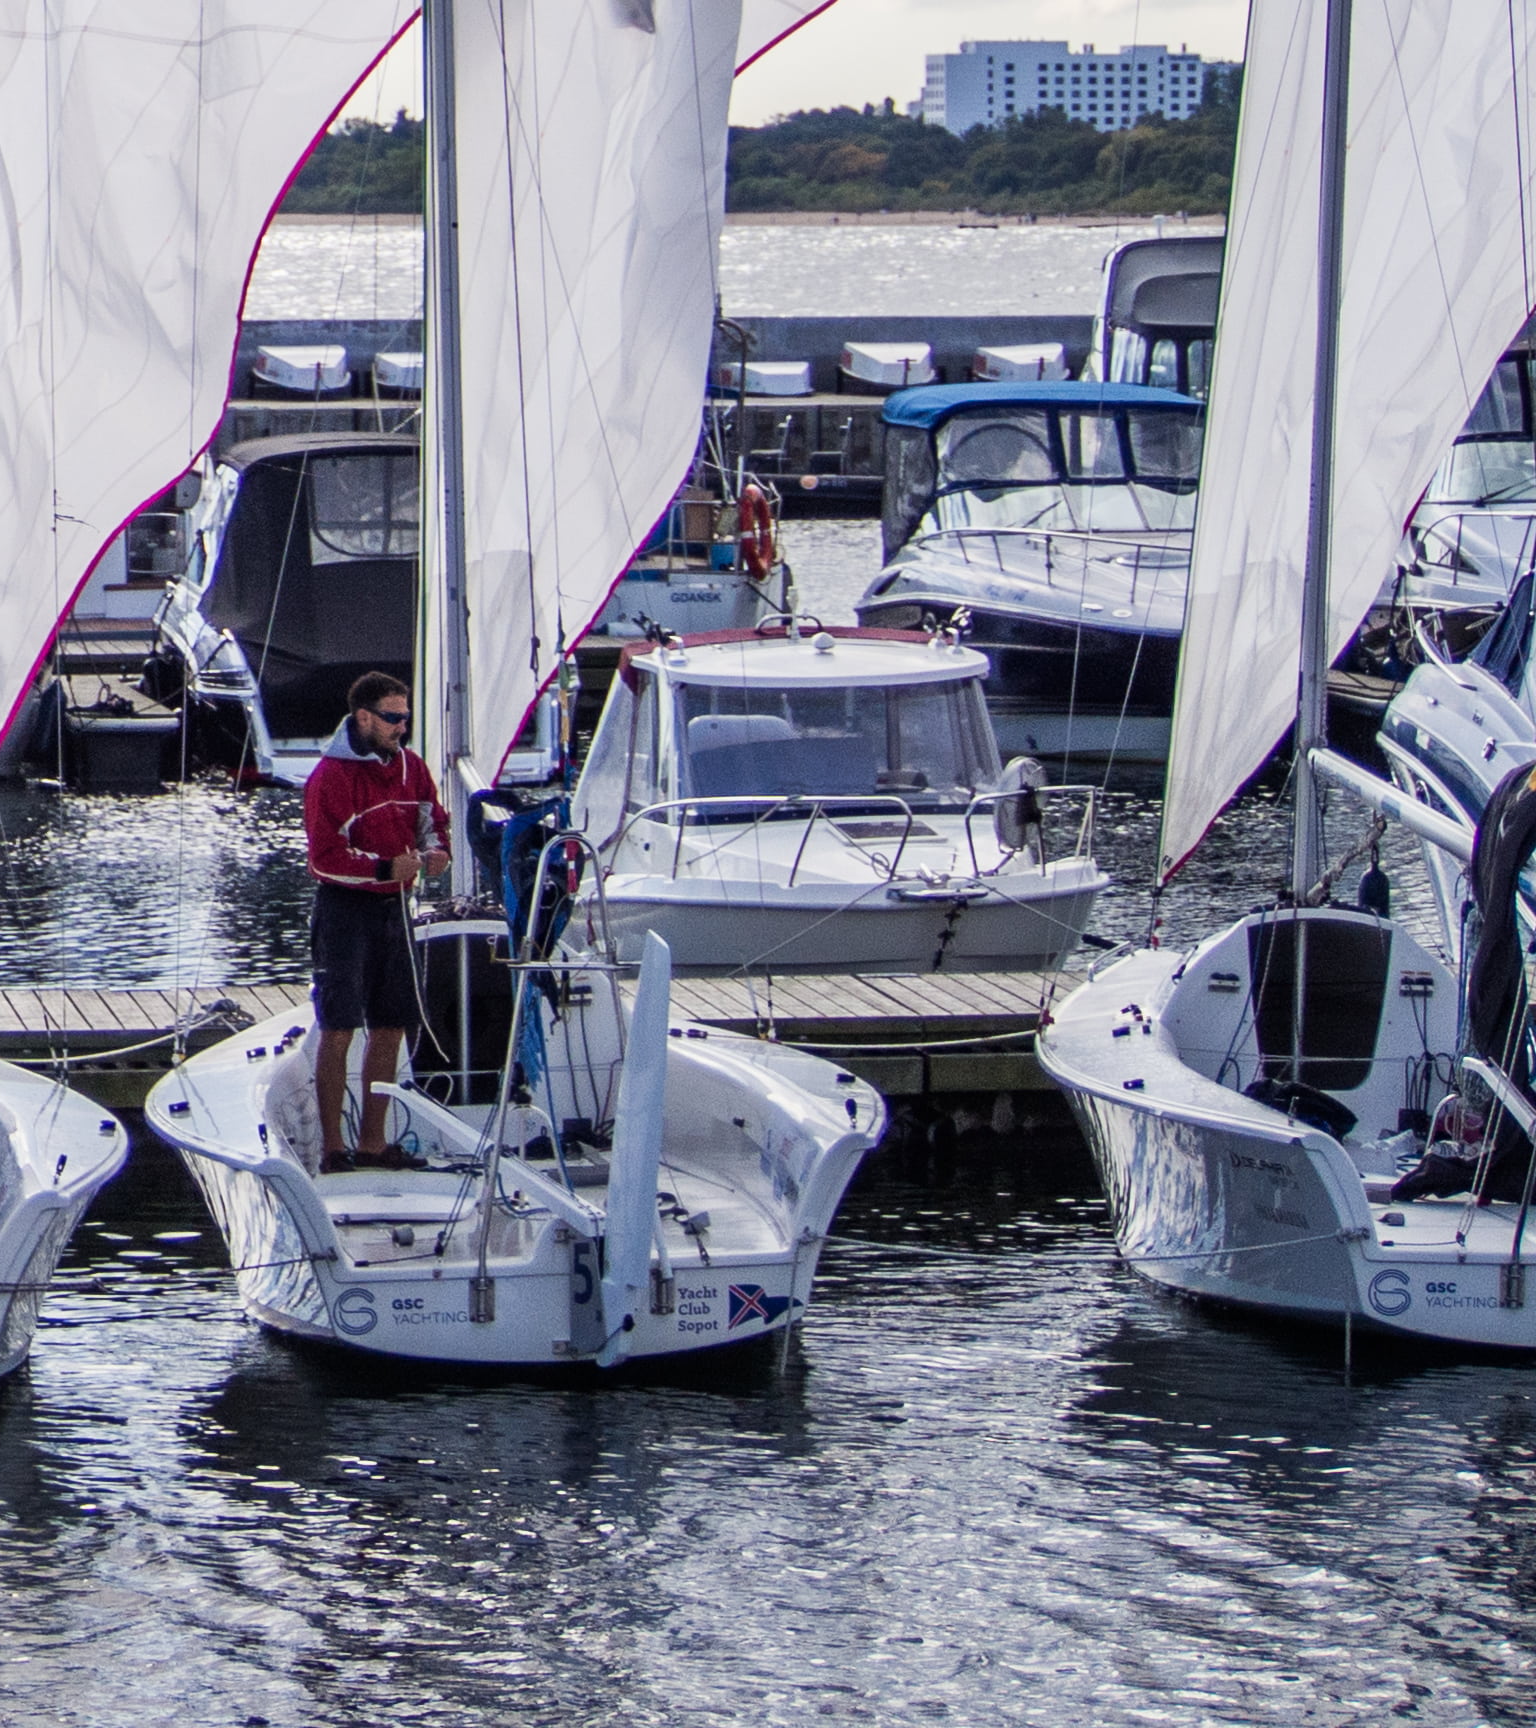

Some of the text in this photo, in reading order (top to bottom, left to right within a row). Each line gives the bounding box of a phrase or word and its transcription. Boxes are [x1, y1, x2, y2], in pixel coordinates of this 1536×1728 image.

[574, 1242, 593, 1305] 5
[1426, 1282, 1457, 1293] GSC
[678, 1287, 718, 1302] Yacht
[392, 1298, 424, 1310] GSC
[678, 1302, 711, 1315] Club
[1426, 1297, 1498, 1309] YACHTING
[392, 1312, 468, 1325] YACHTING
[678, 1319, 719, 1335] Sopot
